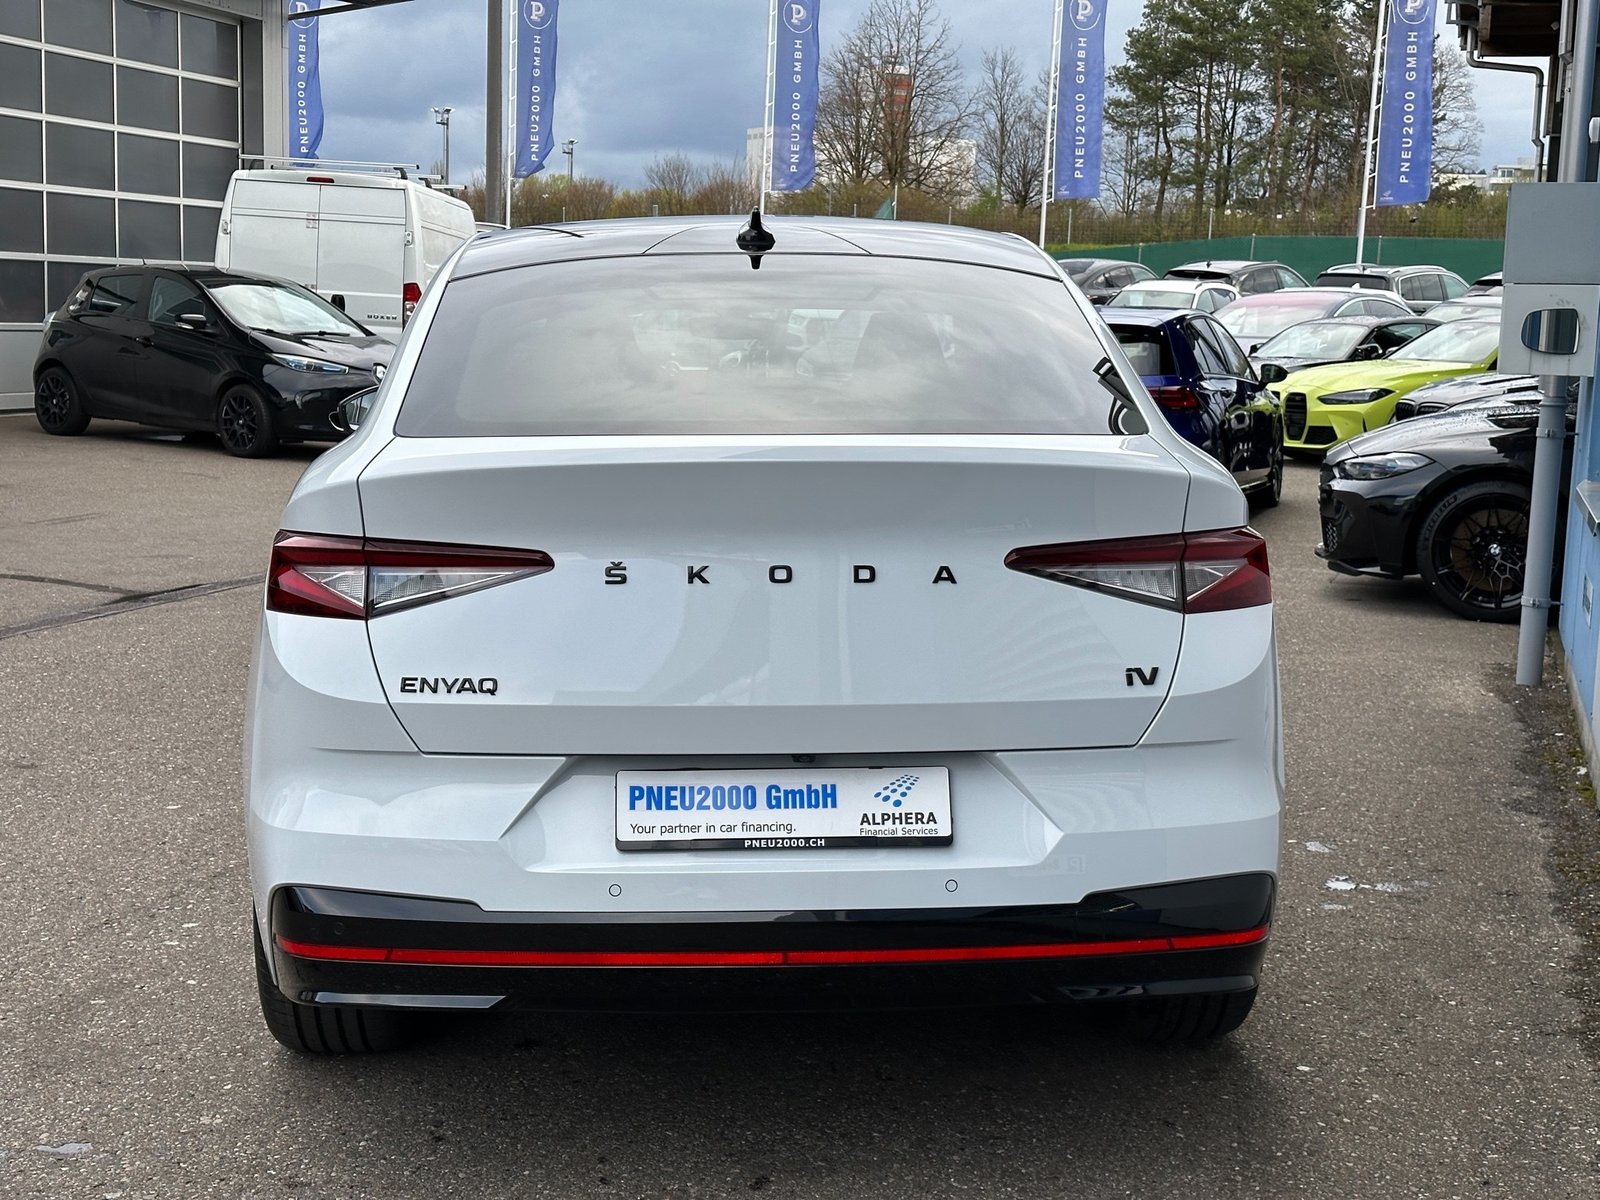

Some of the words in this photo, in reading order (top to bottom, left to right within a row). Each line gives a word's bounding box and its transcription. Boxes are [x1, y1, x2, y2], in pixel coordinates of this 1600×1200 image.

[297, 33, 307, 74] GMBH
[532, 35, 541, 77] GMBH
[793, 39, 803, 83] GMBH
[1075, 37, 1087, 84] GMBH
[1405, 32, 1418, 81] GMBH
[297, 81, 309, 153] PNEU2000
[530, 85, 541, 161] PNEU2000
[790, 92, 801, 172] PNEU2000
[1074, 93, 1086, 178] PNEU2000
[1399, 91, 1415, 183] PNEU2000
[604, 561, 958, 585] ŠKODA
[400, 677, 498, 696] ENYAQ
[628, 784, 757, 811] PNEU2000
[765, 783, 838, 809] GmbH
[630, 823, 656, 834] Your
[659, 823, 702, 836] partner
[705, 823, 717, 833] in
[720, 824, 738, 832] car
[741, 821, 797, 835] financing.
[859, 827, 897, 836] Financial
[901, 826, 939, 835] Services
[860, 812, 938, 826] ALPHERA
[744, 838, 826, 848] PNEU2000.CH
